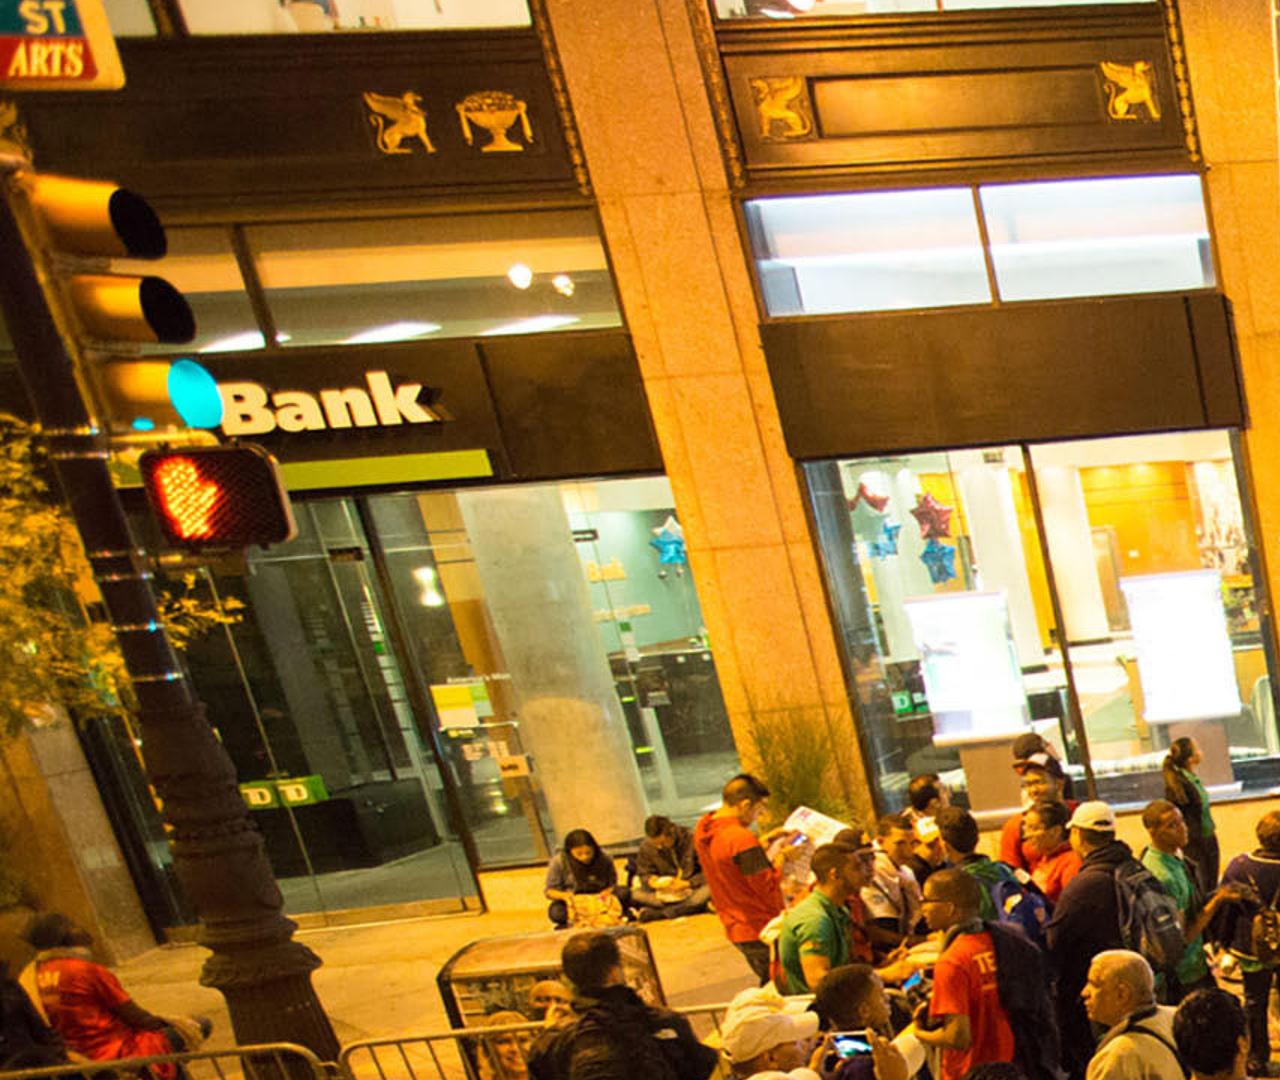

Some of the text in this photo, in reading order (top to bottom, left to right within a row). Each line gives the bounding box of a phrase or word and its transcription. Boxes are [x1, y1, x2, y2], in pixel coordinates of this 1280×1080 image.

[18, 0, 66, 34] ST
[8, 40, 84, 77] ARTS
[216, 370, 435, 437] Bank
[241, 783, 309, 805] TD TD
[971, 951, 997, 974] TE
